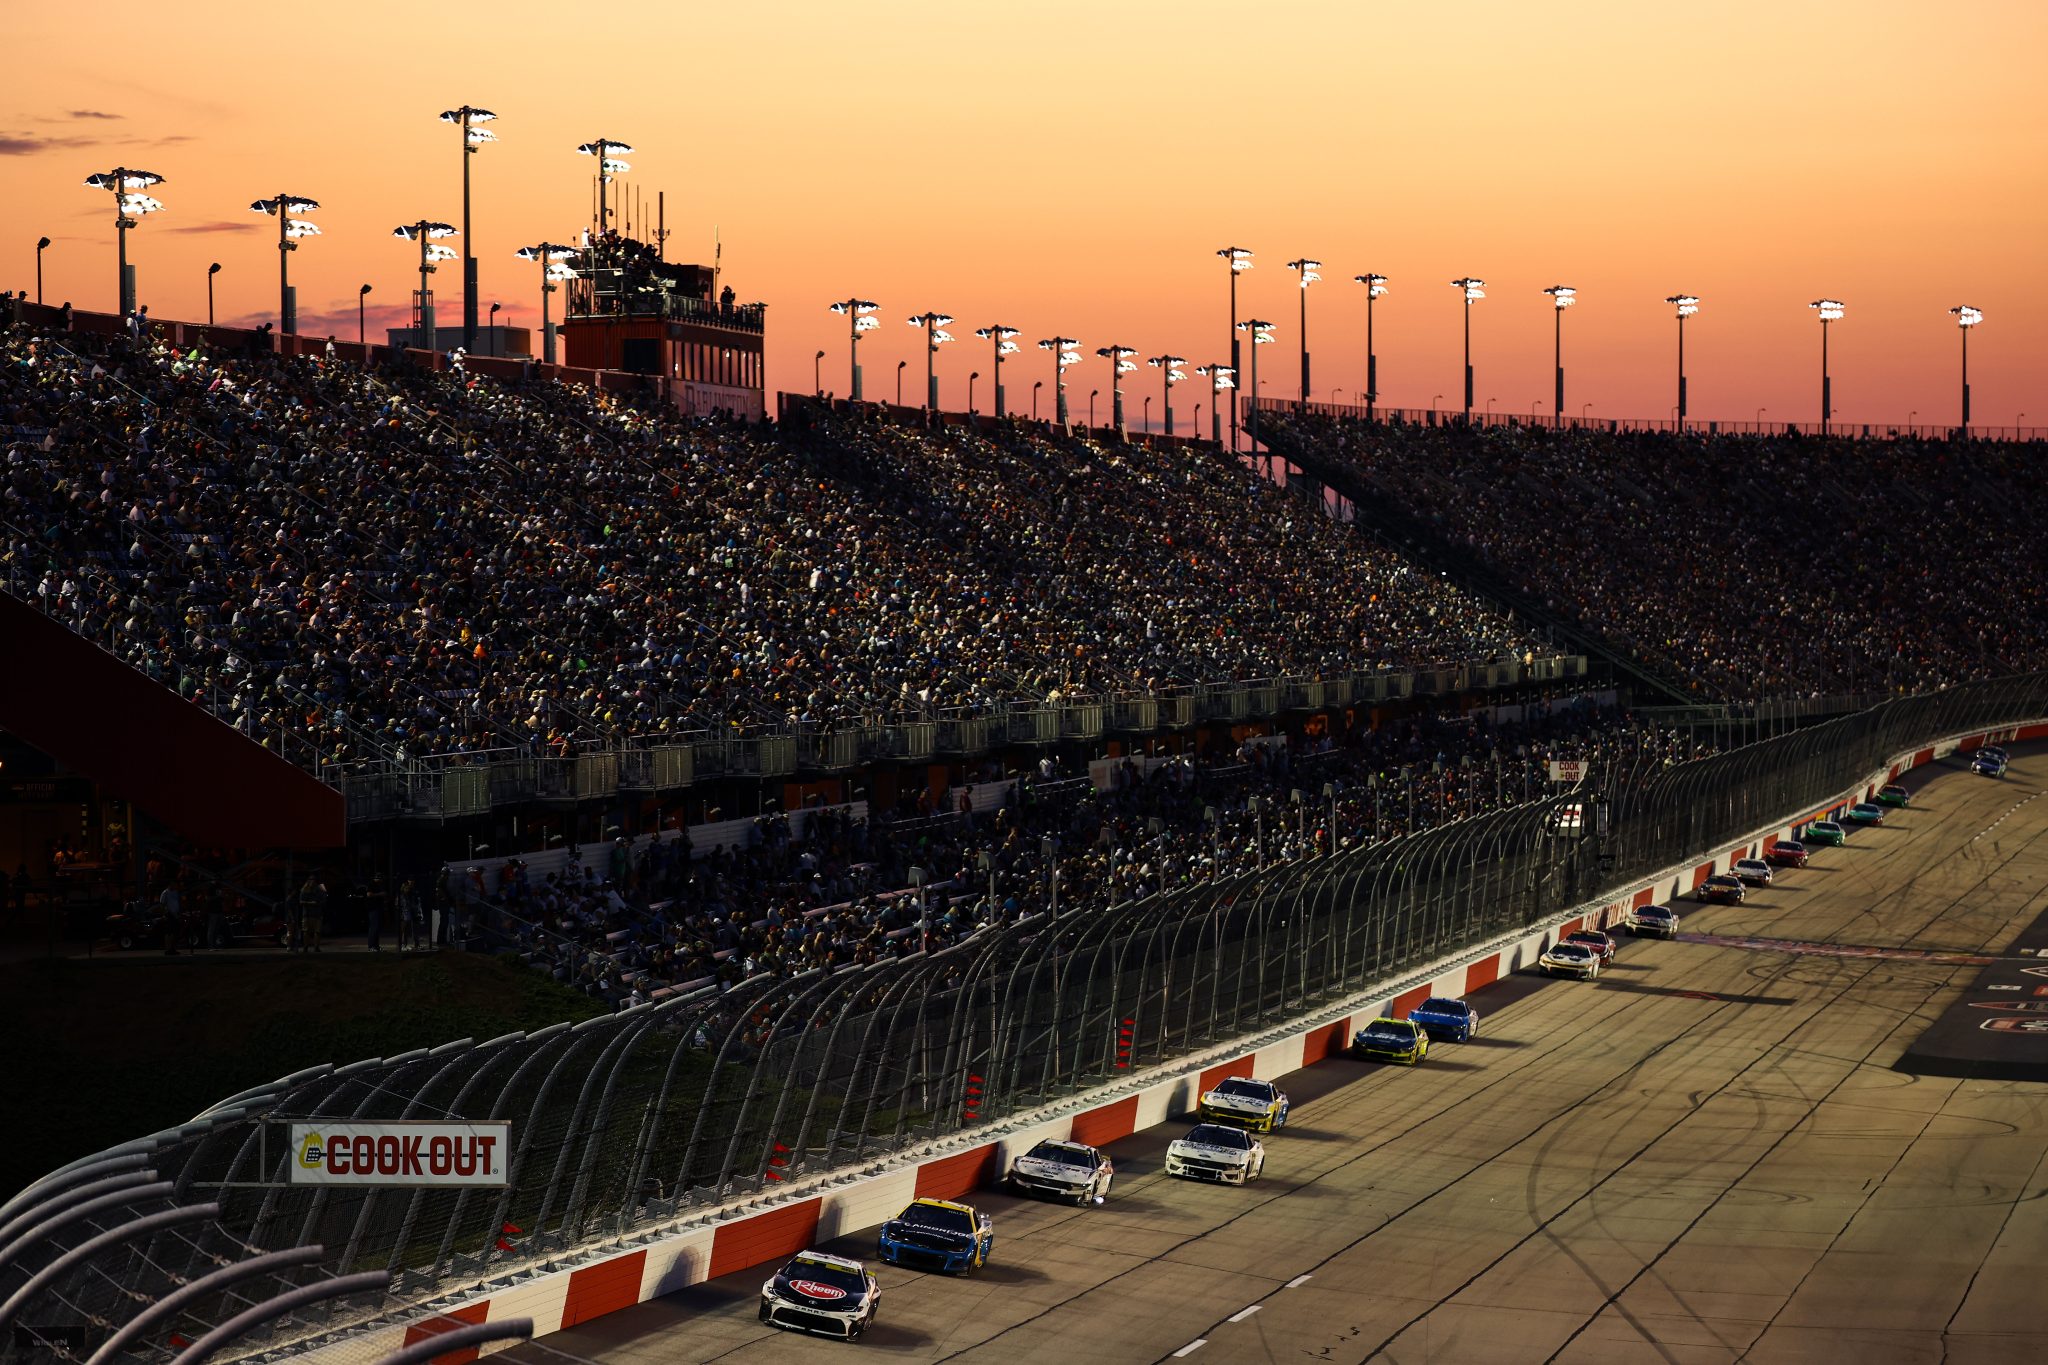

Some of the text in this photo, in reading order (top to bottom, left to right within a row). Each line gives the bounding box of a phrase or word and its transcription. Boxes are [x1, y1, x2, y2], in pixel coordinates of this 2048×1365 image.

[1559, 761, 1580, 771] COOK
[1565, 772, 1580, 780] OUT
[796, 1280, 844, 1298] Rheem
